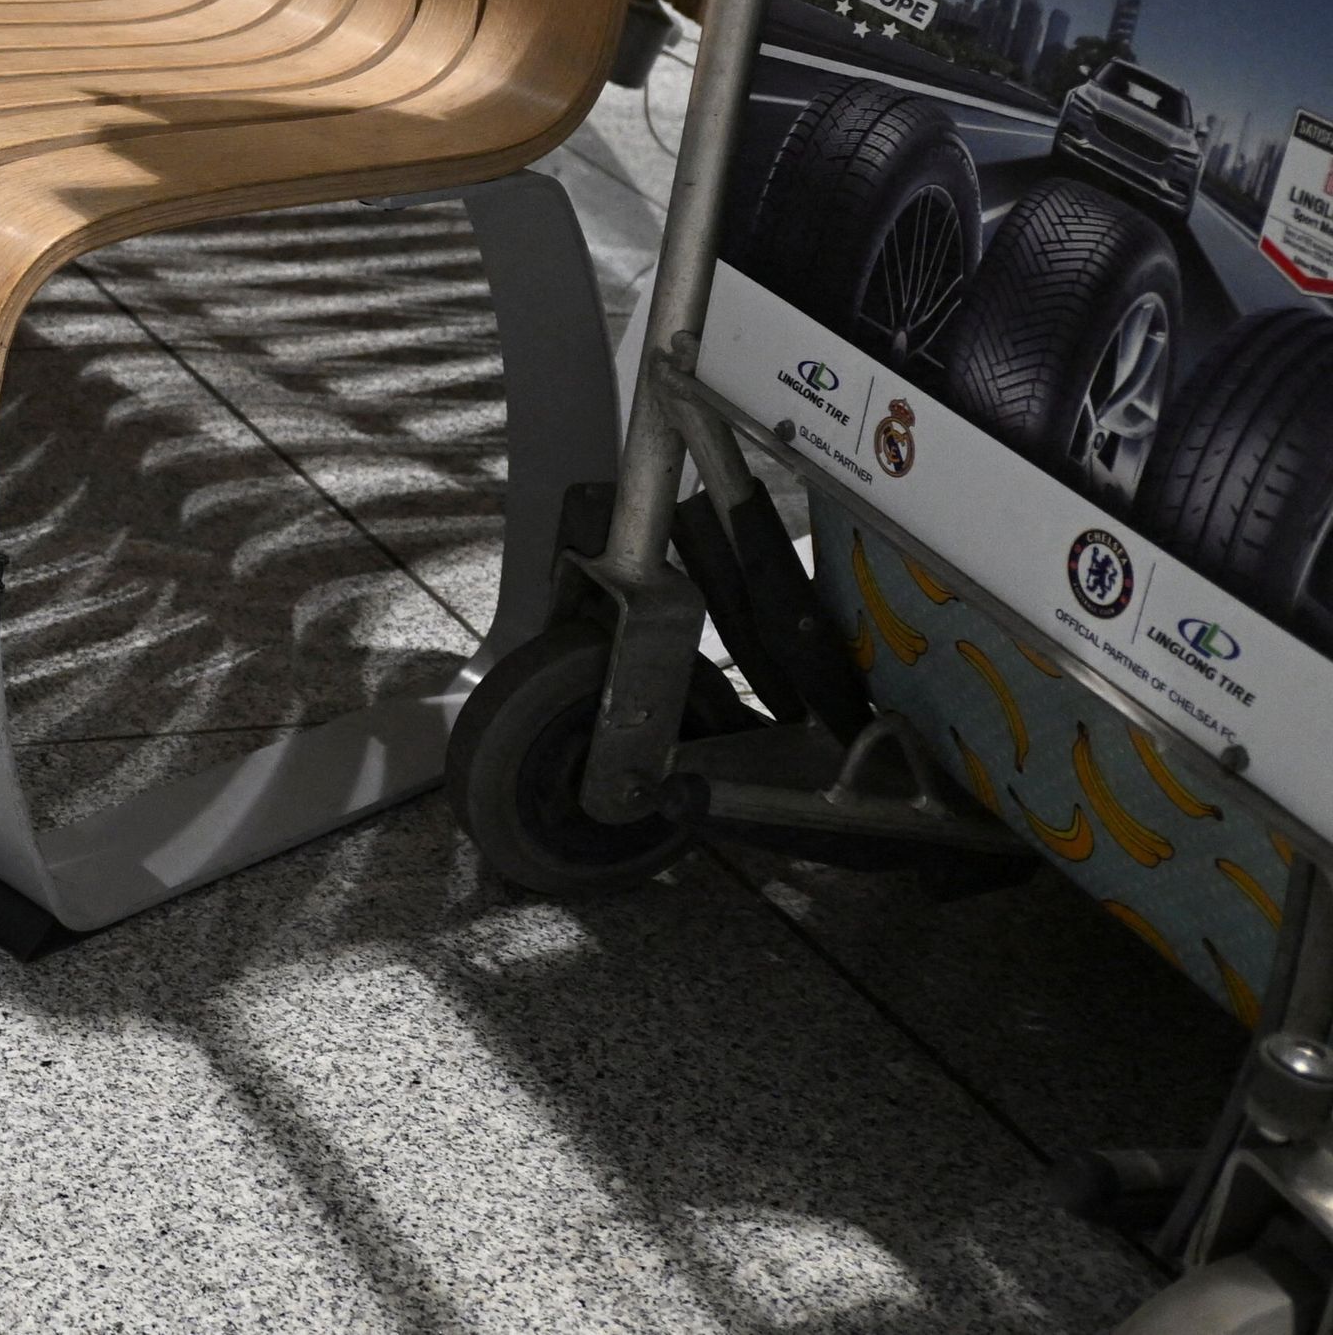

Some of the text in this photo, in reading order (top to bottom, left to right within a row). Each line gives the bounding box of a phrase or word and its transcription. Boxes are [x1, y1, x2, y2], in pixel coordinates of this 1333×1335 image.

[777, 370, 851, 427] LINGLONG TIRE
[799, 425, 874, 486] GLOBAL PARTNER
[1086, 532, 1129, 566] CHELSEA
[1055, 608, 1239, 744] OFFICIAL PARTNER OF CHELSEA FC
[1146, 626, 1257, 708] LINGLONG TIRE
